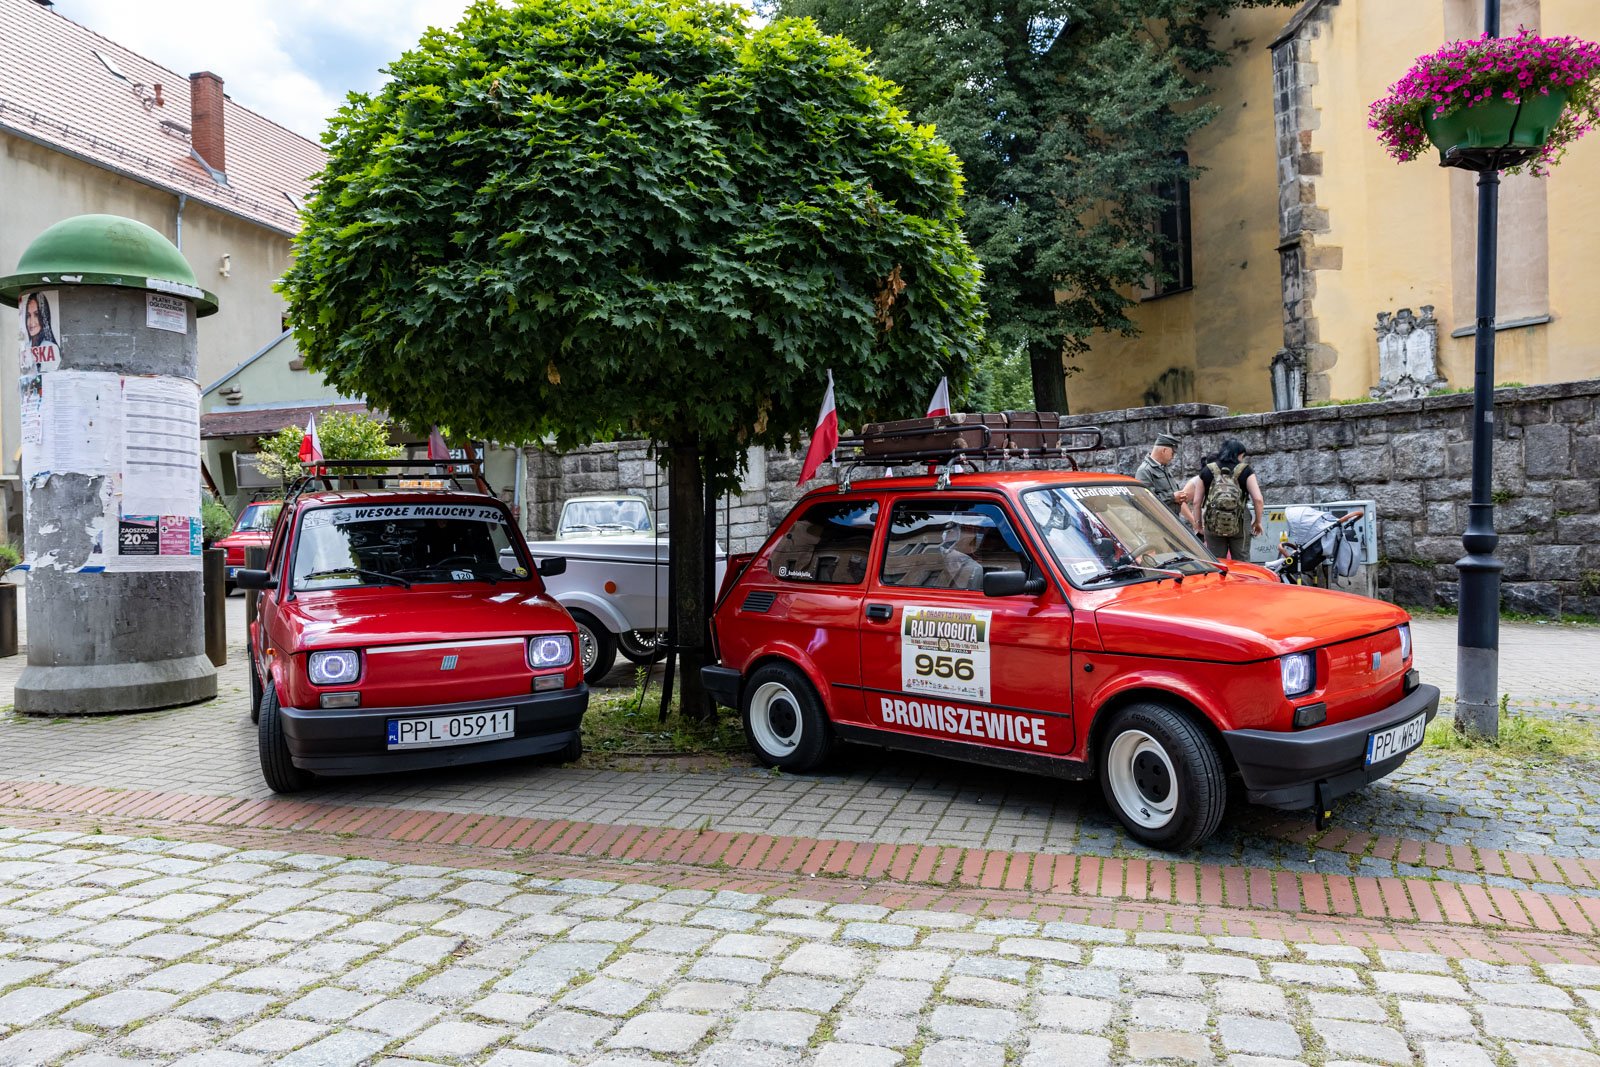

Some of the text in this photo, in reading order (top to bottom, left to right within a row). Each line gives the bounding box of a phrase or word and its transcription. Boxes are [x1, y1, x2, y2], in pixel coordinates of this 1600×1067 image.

[355, 507, 409, 519] WESOŁE
[414, 505, 475, 518] MALUCHY
[455, 572, 471, 580] 120
[910, 619, 936, 638] RAJD
[937, 621, 978, 643] KOGUTA
[915, 653, 975, 681] 956
[400, 712, 510, 742] PPL 05911
[880, 697, 1048, 747] BRONISZEWICE
[1374, 716, 1424, 761] PPL WR31
